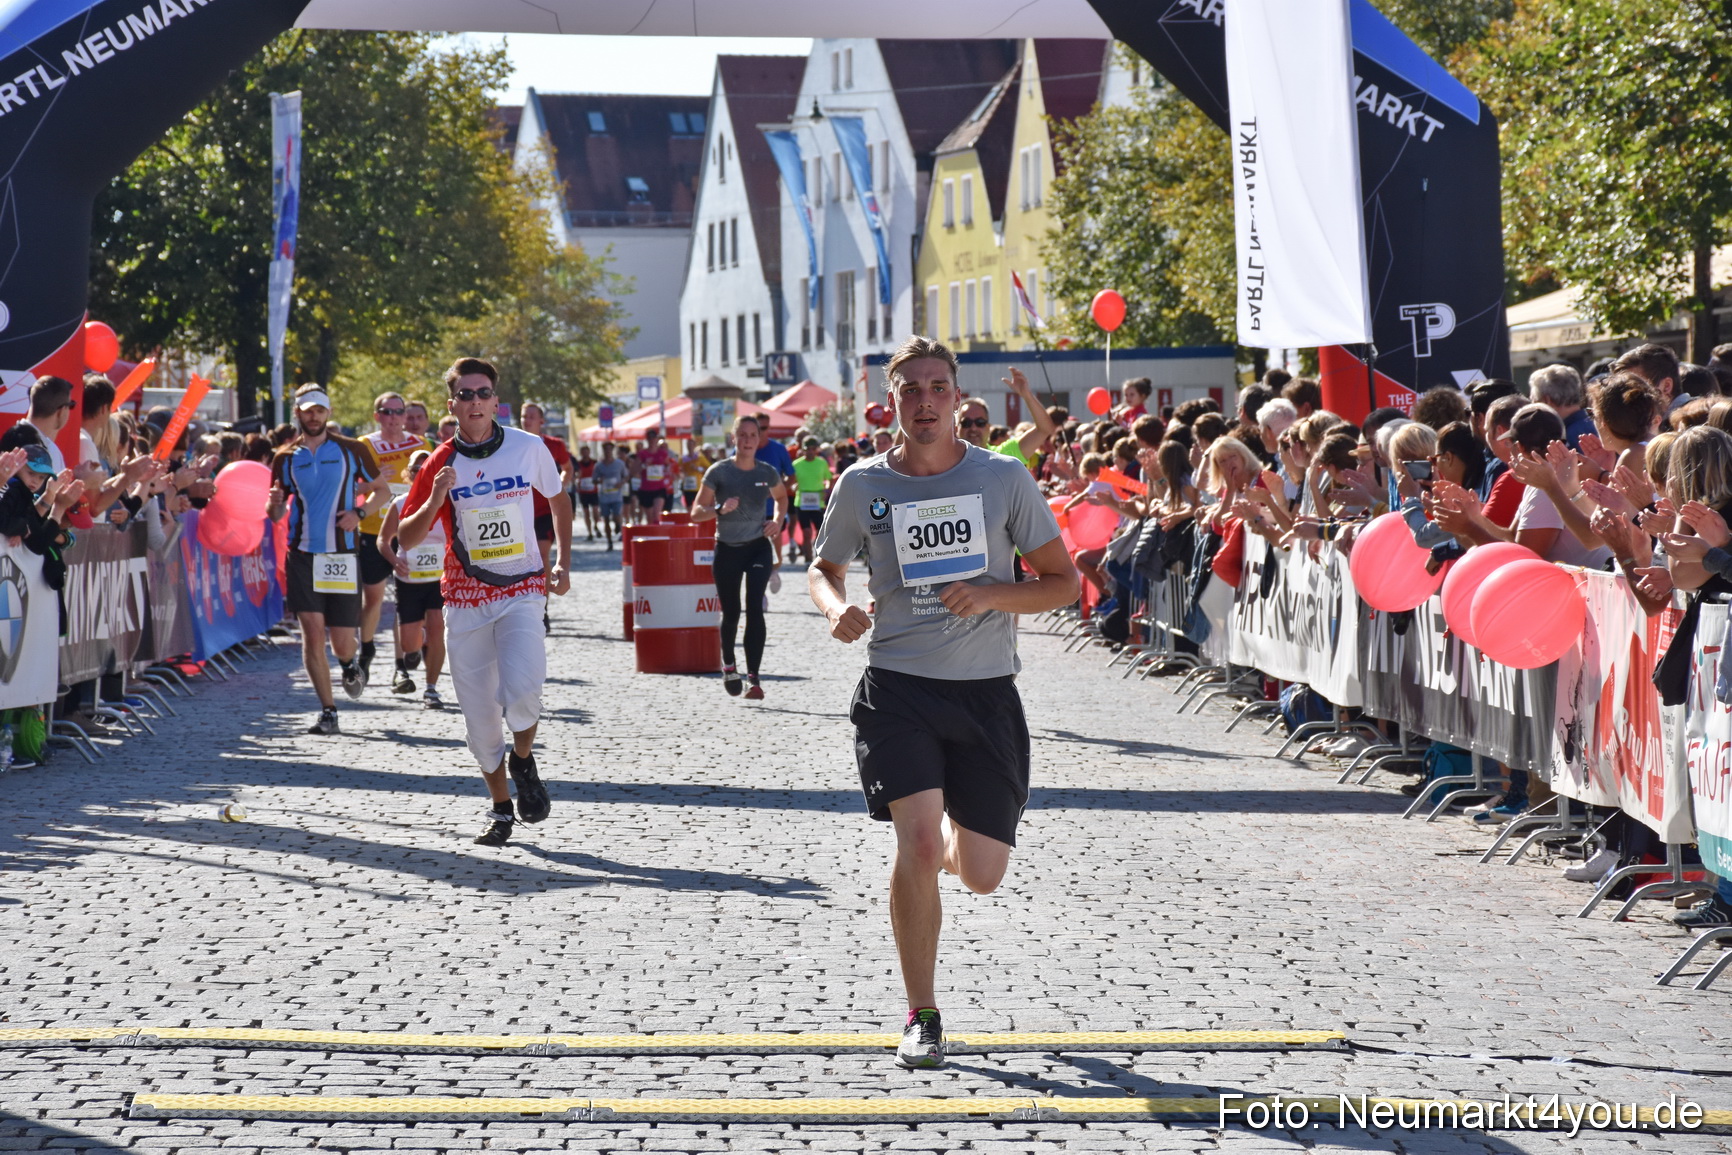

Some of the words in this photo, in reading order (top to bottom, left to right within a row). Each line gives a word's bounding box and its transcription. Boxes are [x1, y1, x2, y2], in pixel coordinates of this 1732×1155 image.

[1388, 393, 1413, 406] THE
[918, 504, 956, 517] BOCK
[478, 520, 510, 541] 220
[870, 523, 891, 531] PARTL
[907, 518, 971, 550] 3009
[416, 553, 437, 566] 226
[481, 548, 513, 558] Christian
[916, 551, 934, 559] PARTL
[935, 549, 961, 557] Neumarkt
[324, 563, 348, 576] 332
